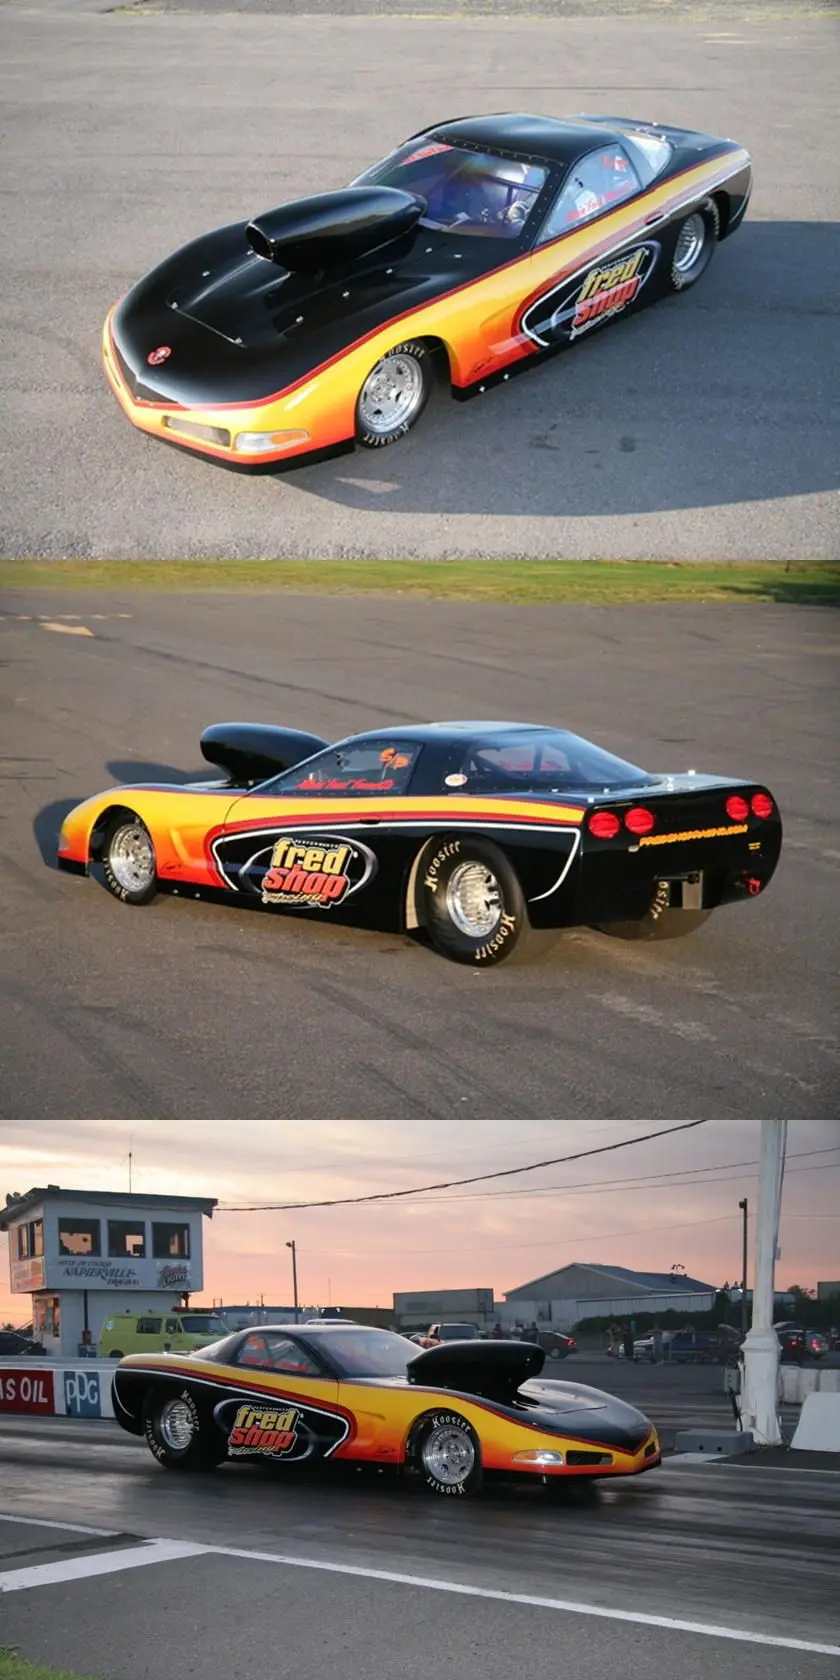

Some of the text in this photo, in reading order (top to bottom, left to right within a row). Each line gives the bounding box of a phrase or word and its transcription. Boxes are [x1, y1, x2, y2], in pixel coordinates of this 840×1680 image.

[271, 839, 349, 875] fred
[424, 840, 461, 893] Hoosier
[263, 864, 347, 903] shop
[474, 911, 517, 960] Hoosier
[20, 1377, 48, 1403] OIL
[235, 1406, 297, 1431] fred
[432, 1415, 471, 1432] Hoosier
[229, 1425, 296, 1453] shop
